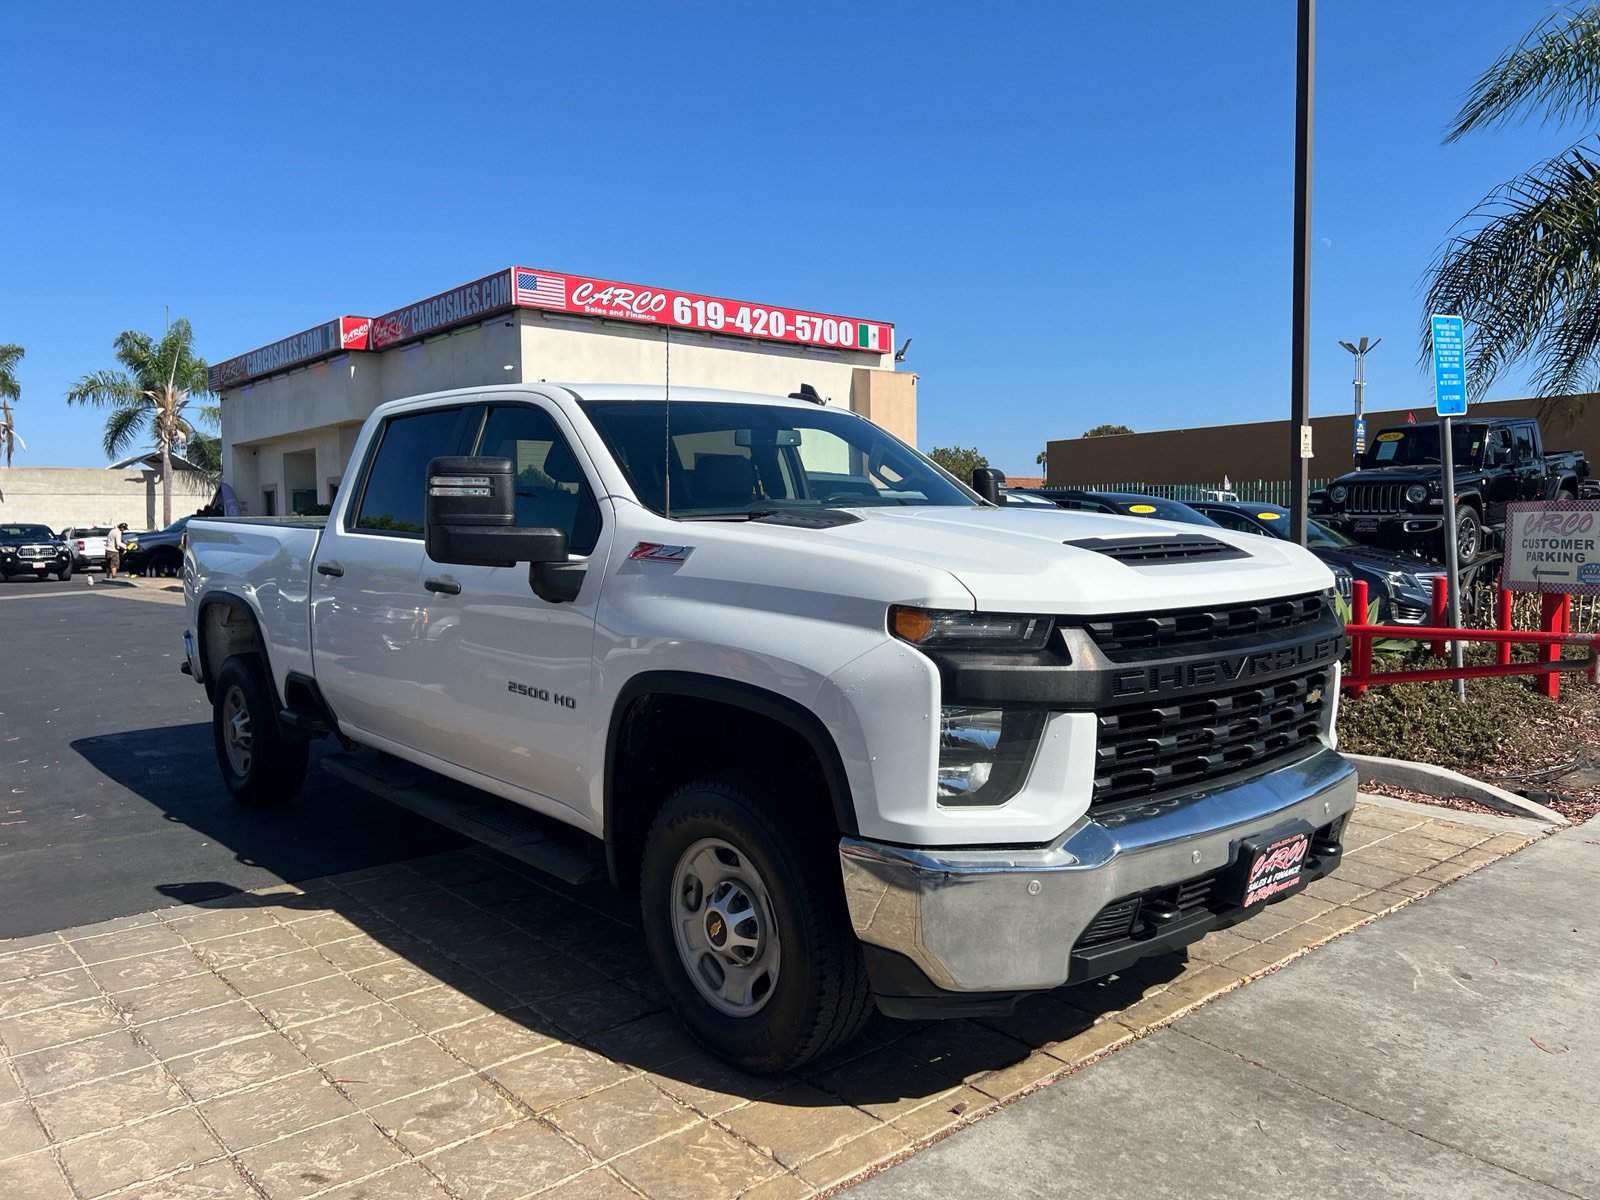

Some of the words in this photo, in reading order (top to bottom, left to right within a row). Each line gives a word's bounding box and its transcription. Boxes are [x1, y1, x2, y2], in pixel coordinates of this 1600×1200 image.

[411, 273, 511, 334] CARCOSALES.COM
[571, 282, 666, 314] CARCO
[673, 296, 854, 346] 619-420-5700
[584, 305, 607, 315] Sales
[609, 308, 624, 317] and
[625, 310, 656, 321] Finance
[343, 324, 369, 343] CARCO
[246, 328, 322, 377] CARCOSALES.COM
[1523, 512, 1594, 537] CARCO
[1522, 538, 1595, 551] CUSTOMER
[1526, 551, 1586, 563] PARKING
[1112, 635, 1343, 698] CHEVROLET
[508, 680, 550, 702] 2500
[554, 692, 577, 709] HD
[1249, 838, 1308, 883] CARCO
